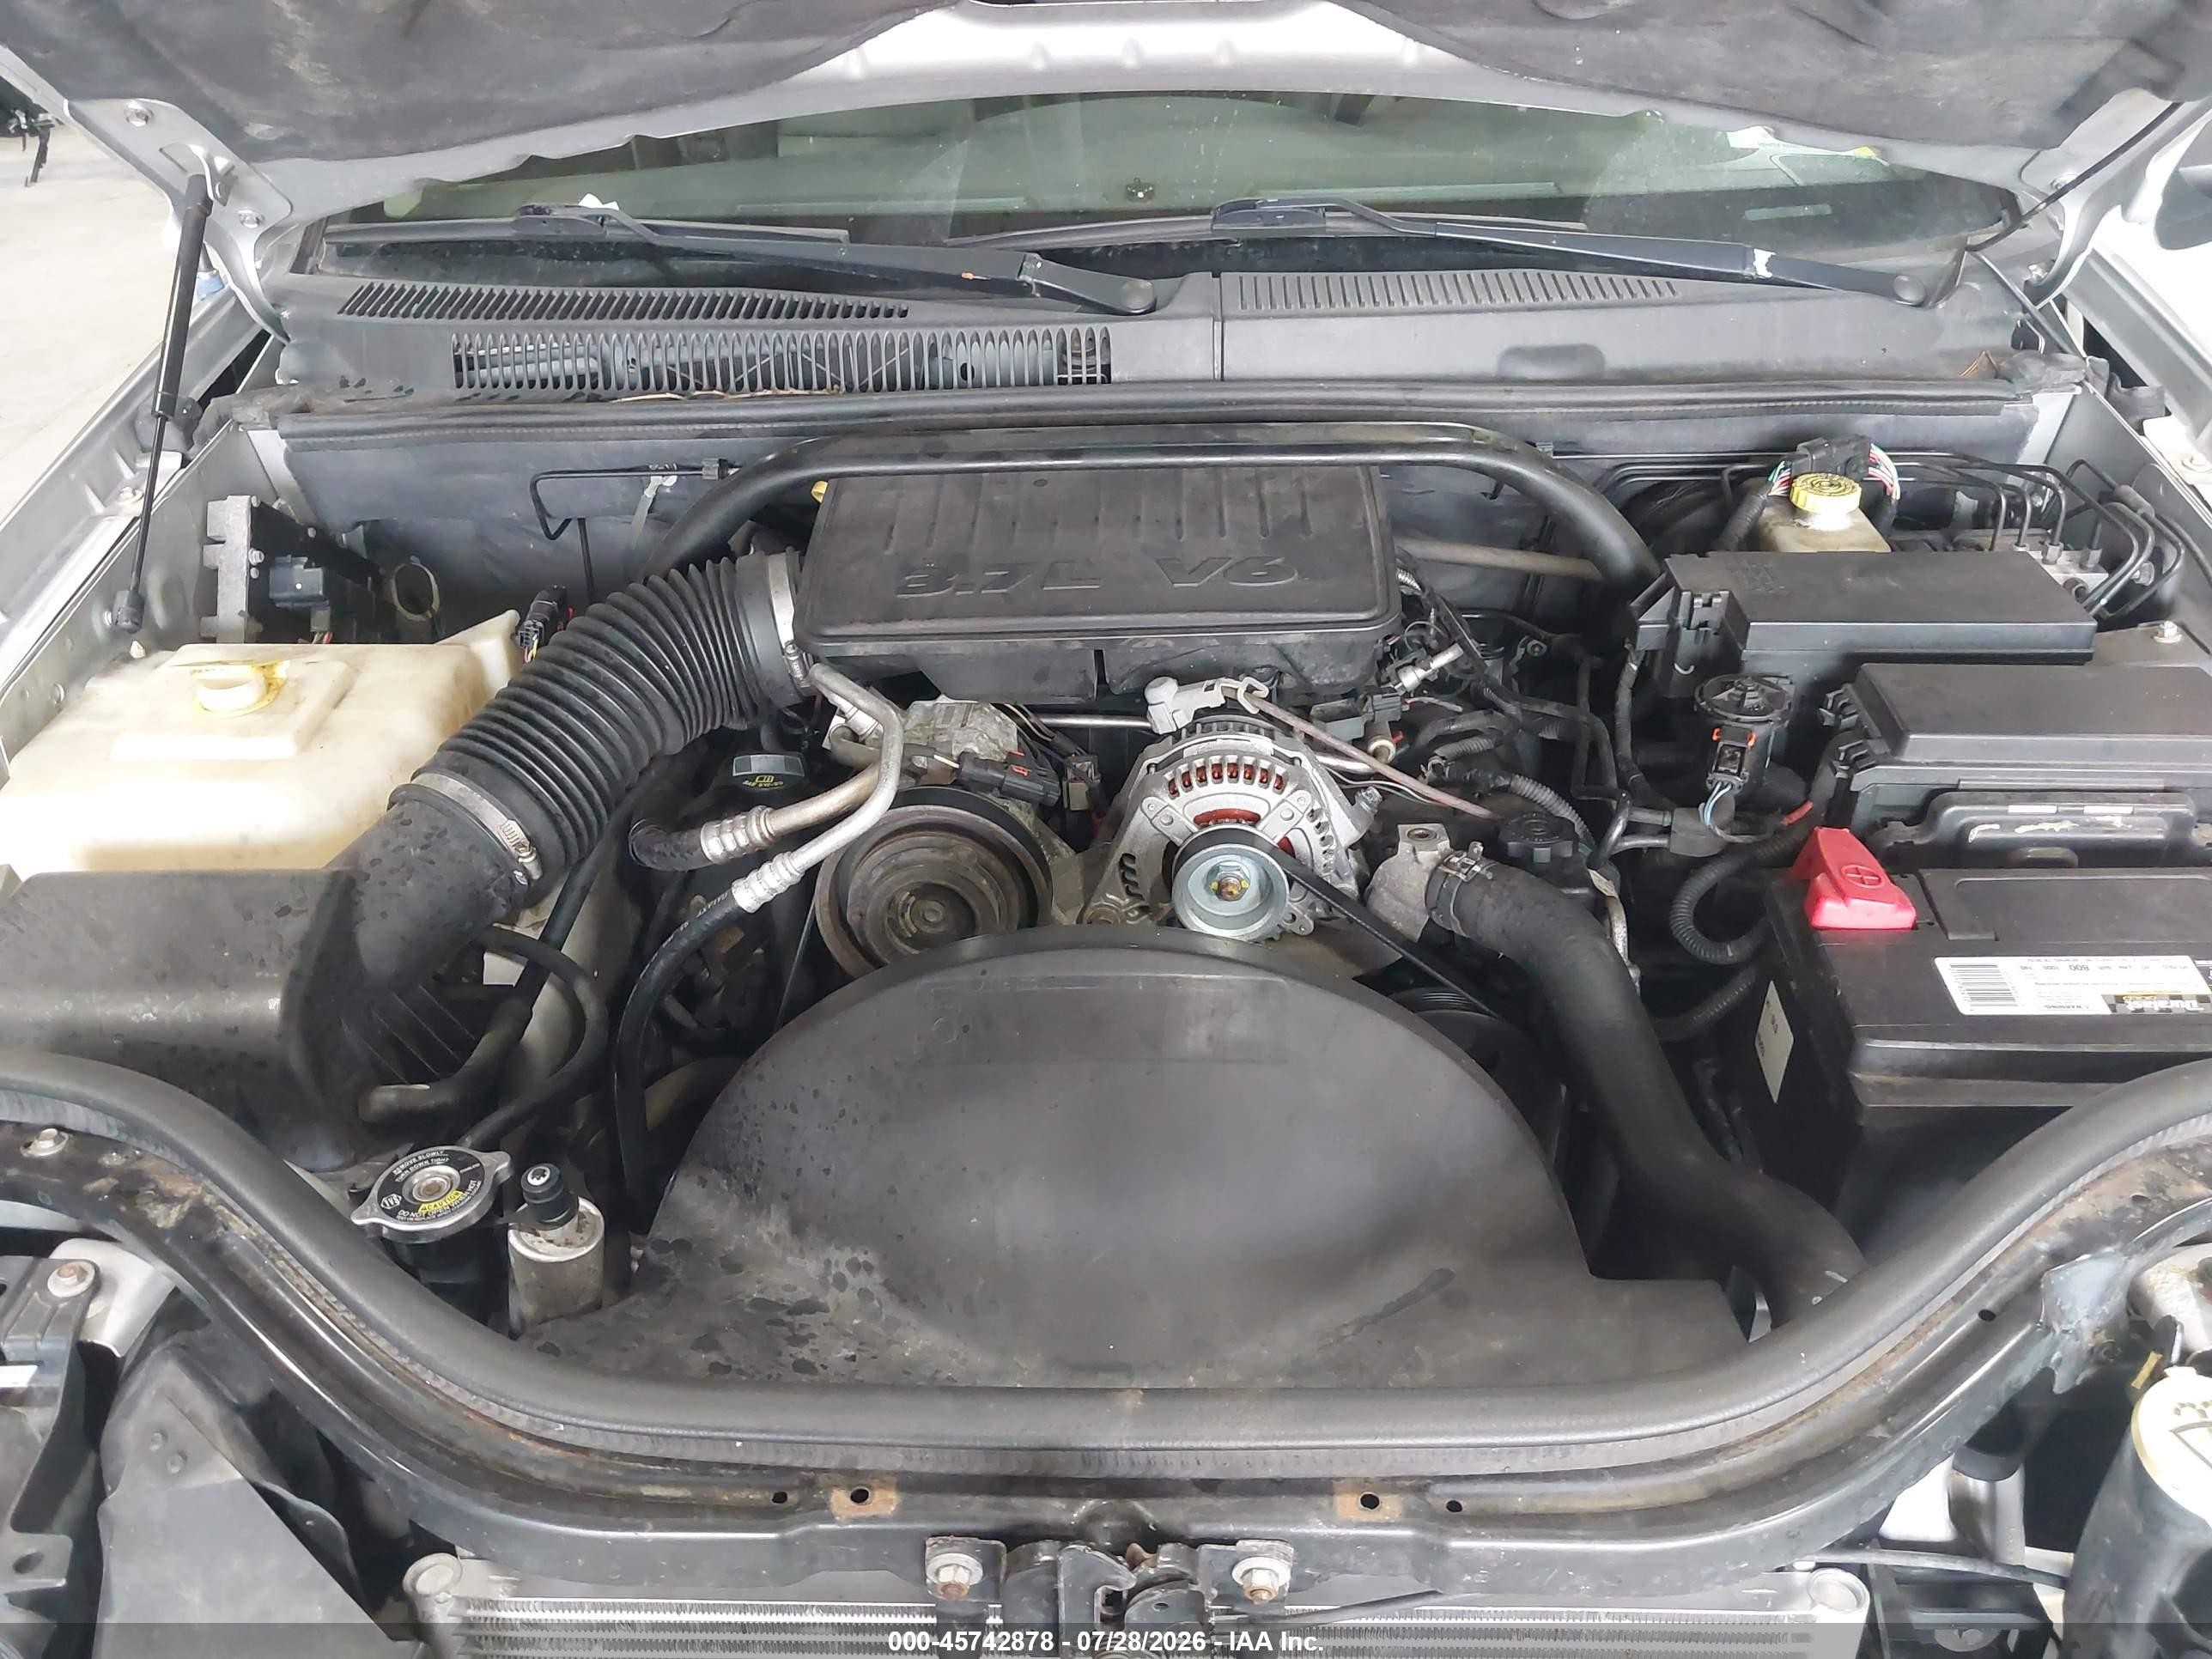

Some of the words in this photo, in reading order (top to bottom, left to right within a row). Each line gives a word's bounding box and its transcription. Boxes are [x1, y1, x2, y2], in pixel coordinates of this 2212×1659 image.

[896, 558, 1102, 598] 3.7L
[1157, 555, 1298, 587] V6
[2125, 1000, 2204, 1012] Duralast
[392, 1157, 417, 1176] REMOVE
[409, 1159, 429, 1172] DOWN
[398, 1209, 410, 1218] DO
[410, 1210, 427, 1218] NOT
[428, 1206, 451, 1217] OPEN
[449, 1190, 471, 1212] WHEN
[466, 1180, 477, 1192] HOT
[427, 1191, 461, 1211] CAUTION
